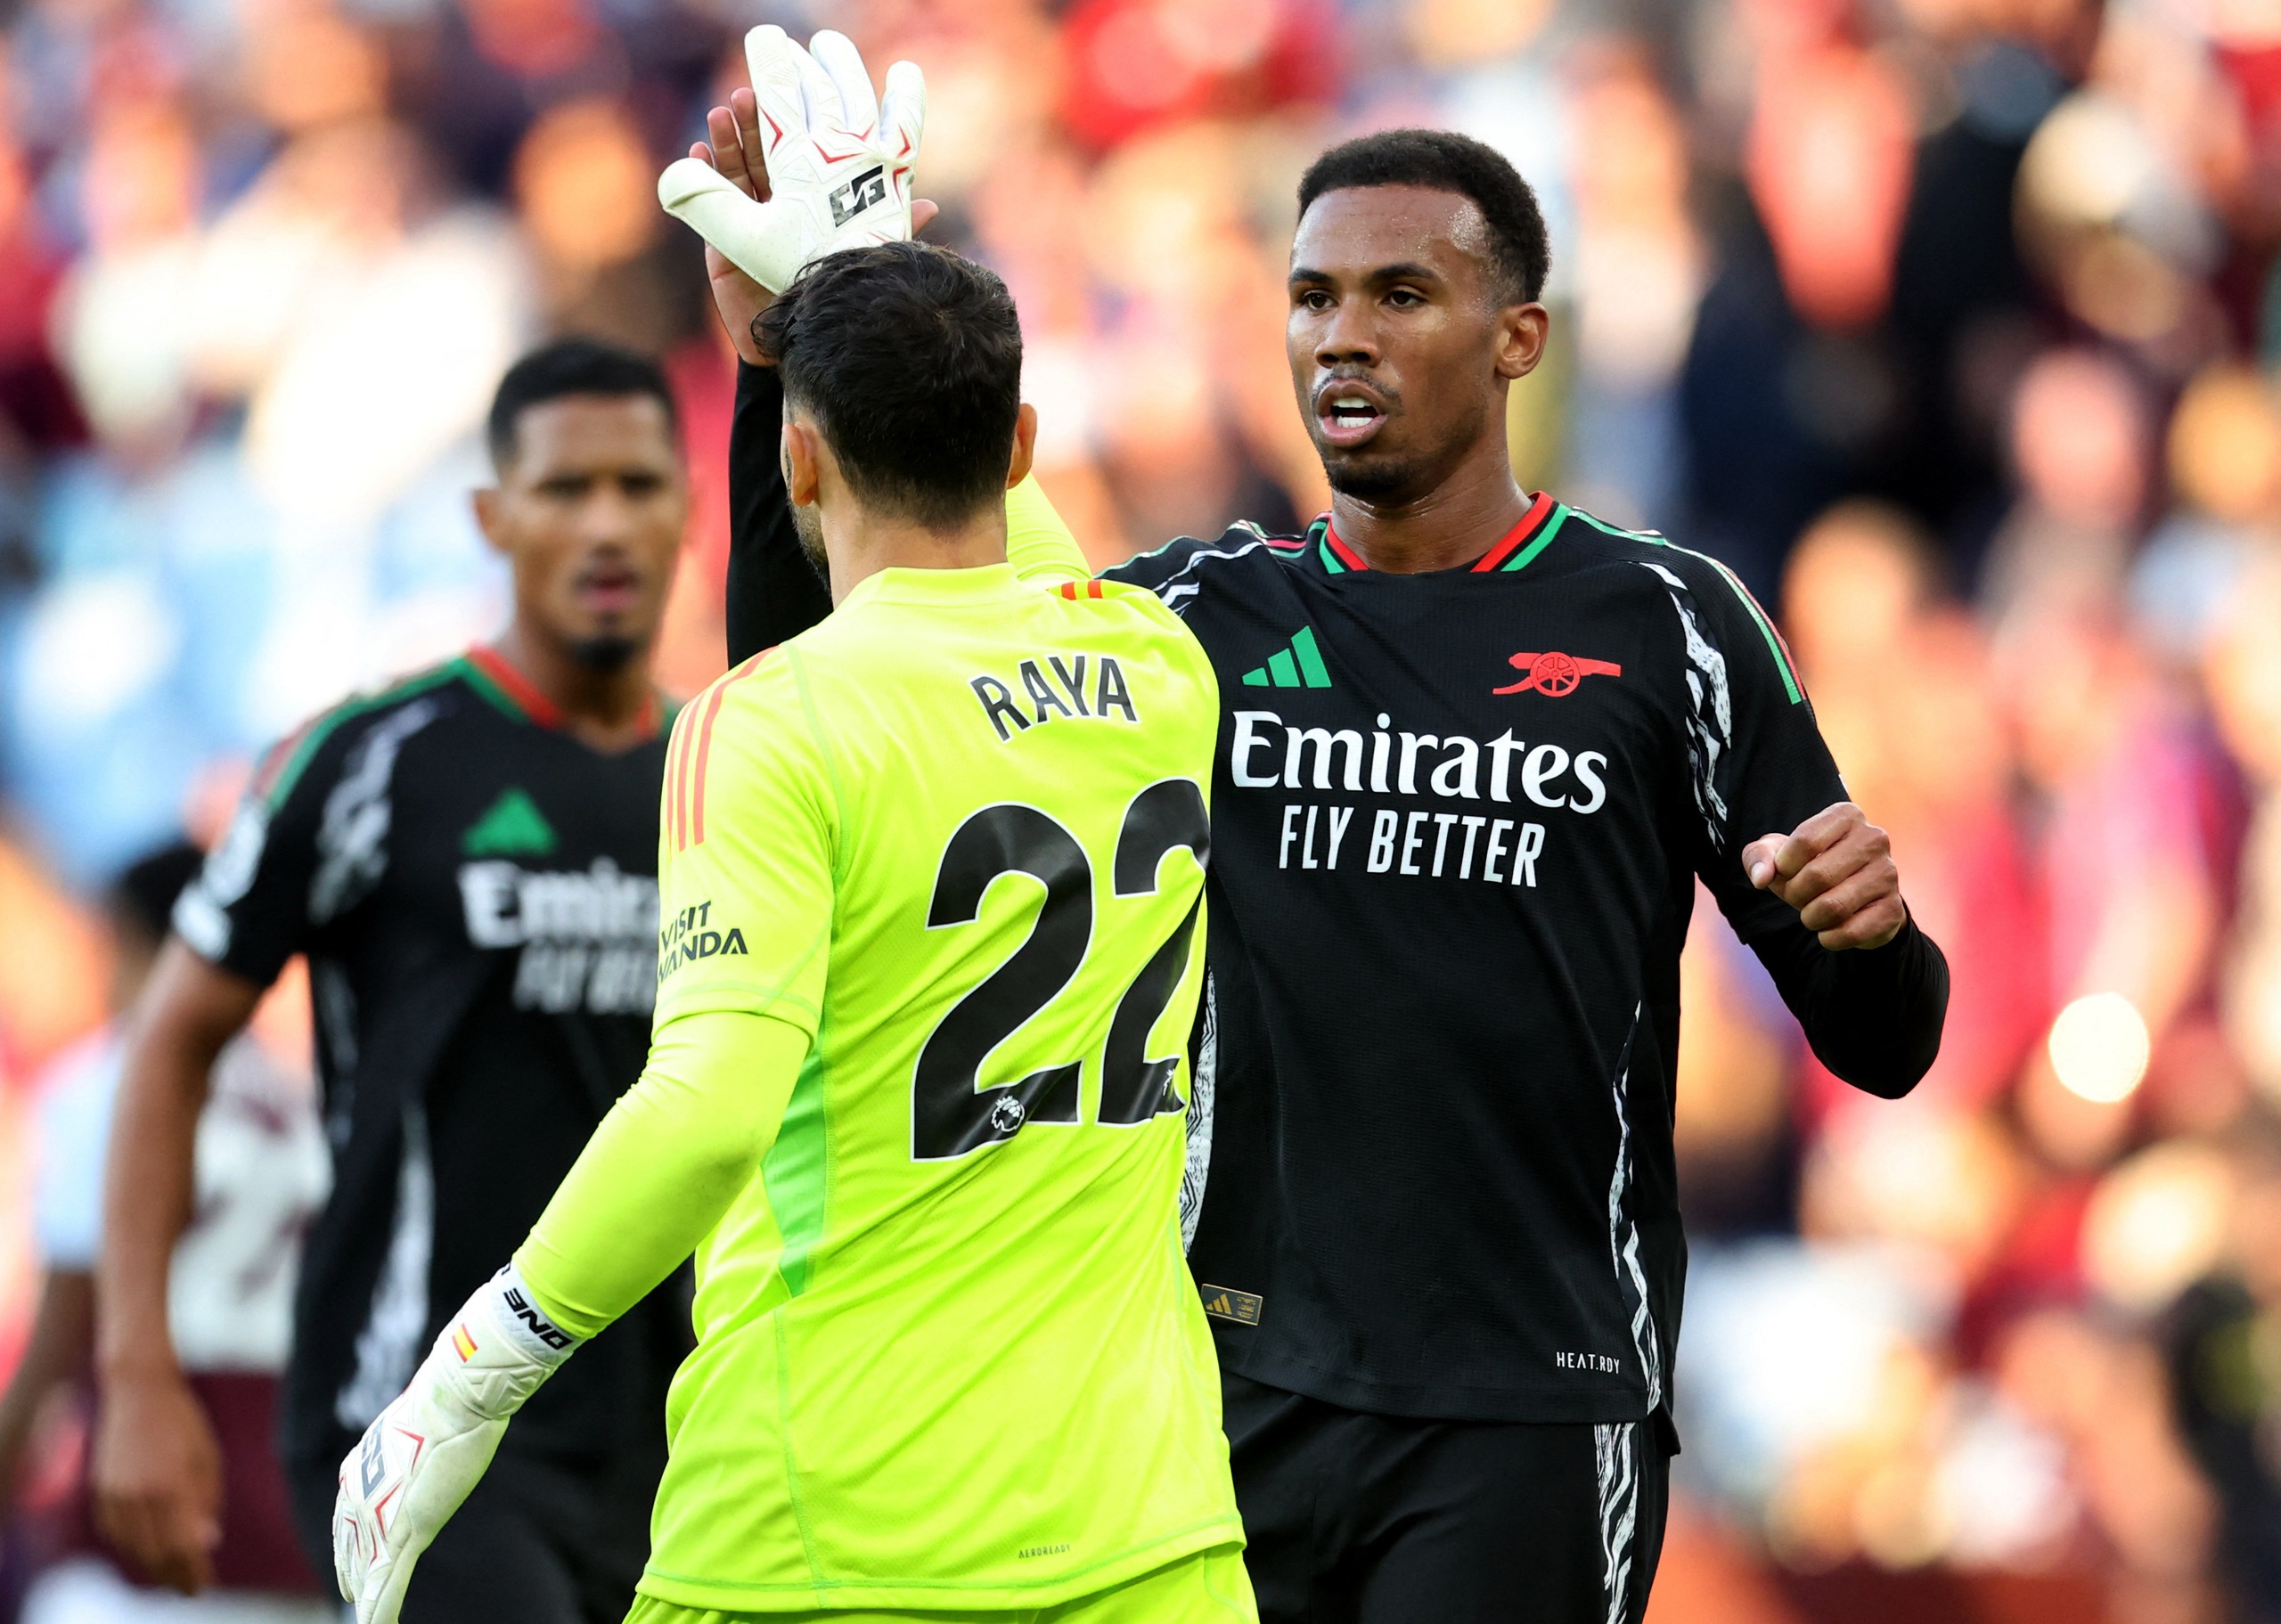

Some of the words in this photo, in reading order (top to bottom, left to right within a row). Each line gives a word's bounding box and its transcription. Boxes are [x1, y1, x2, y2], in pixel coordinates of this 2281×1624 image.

[970, 655, 1138, 742] RAYA
[1231, 710, 1608, 814] Emirates
[1279, 804, 1354, 870] FLY
[1366, 809, 1546, 887] BETTER
[661, 900, 711, 952] VISIT
[911, 776, 1211, 1162] 22
[503, 1287, 574, 1351] ONE
[1557, 1351, 1620, 1375] HEAT.RDY
[1018, 1544, 1070, 1559] AEROREADY
